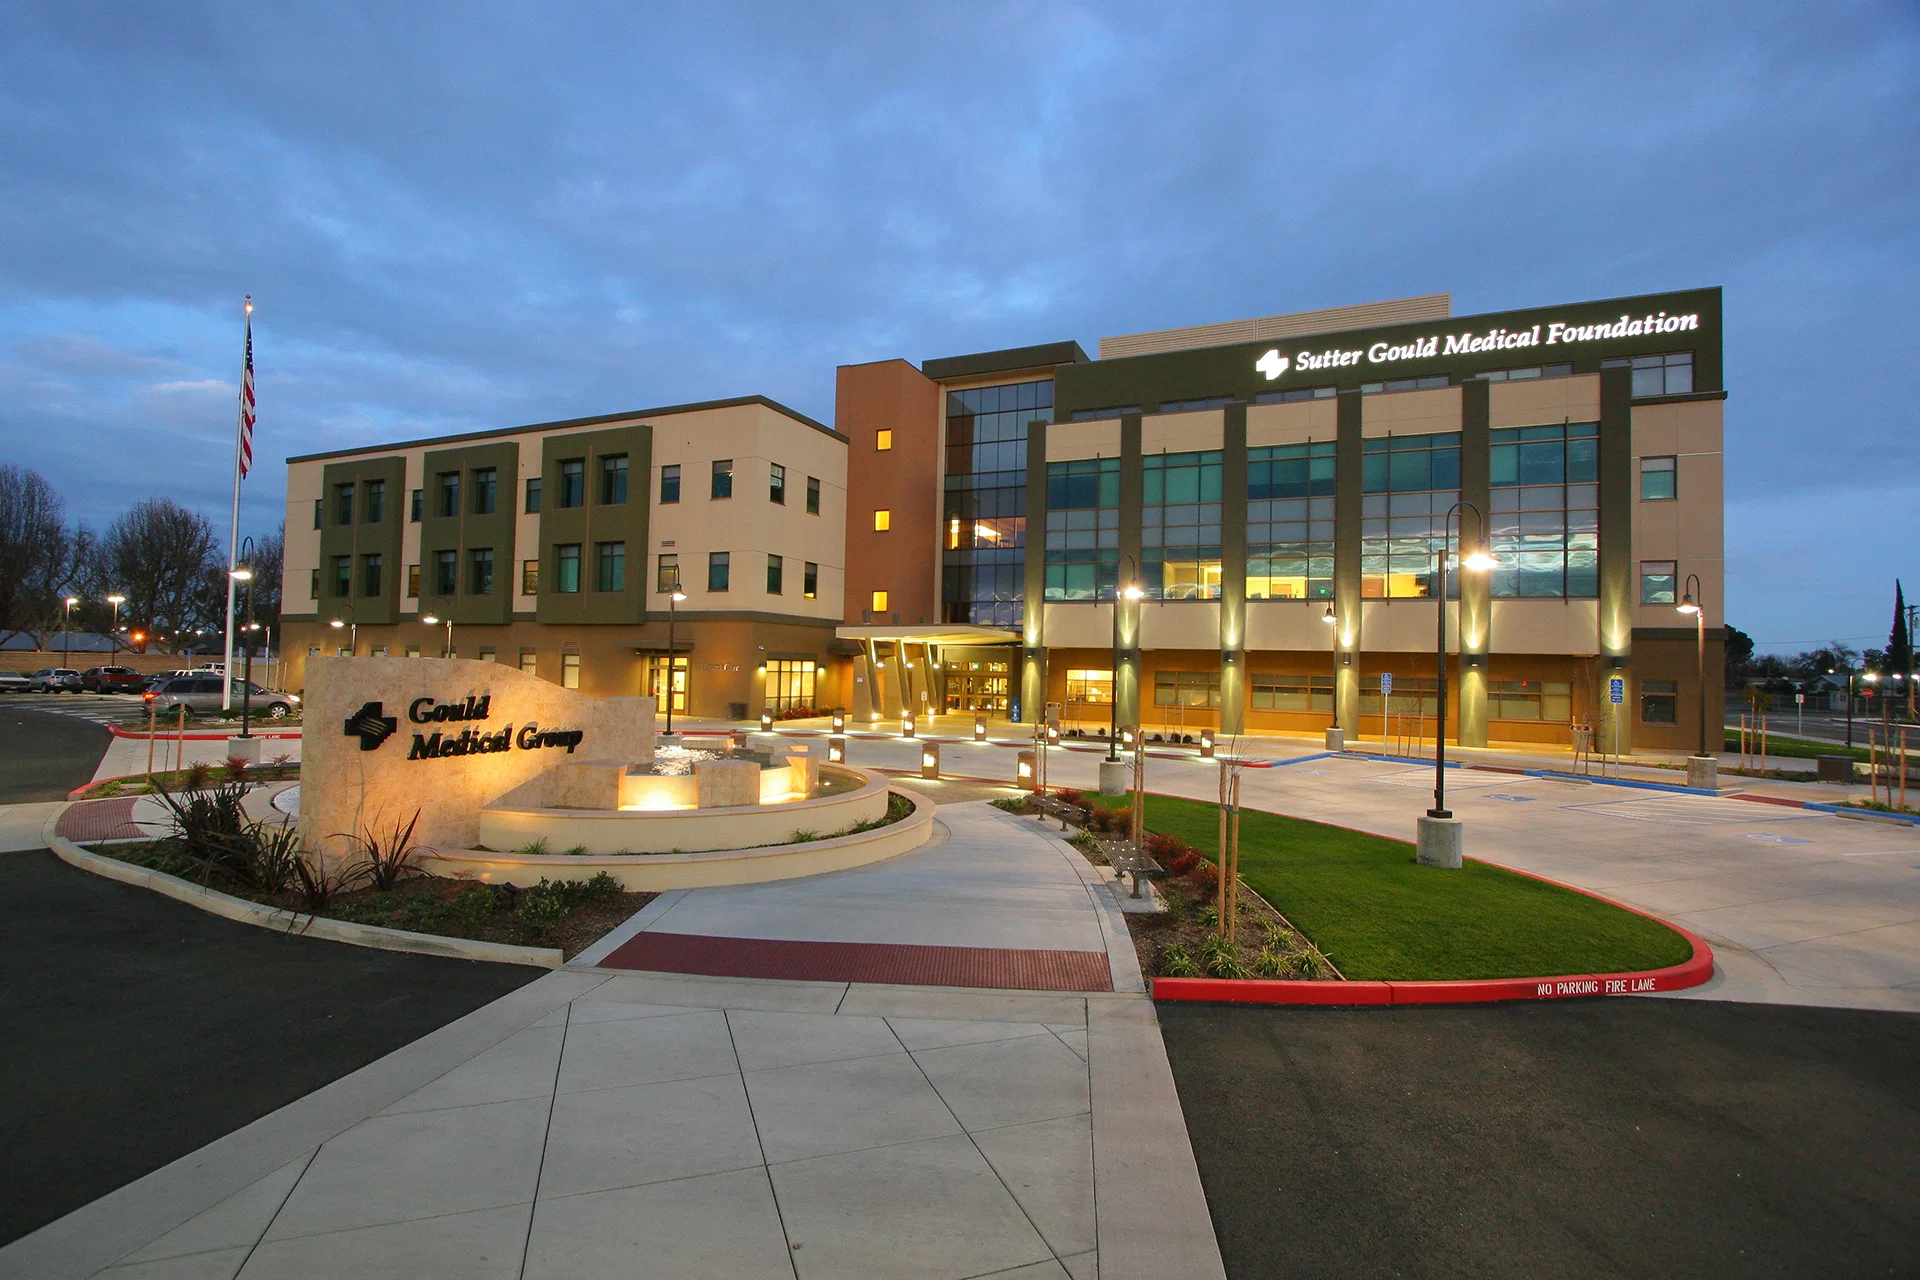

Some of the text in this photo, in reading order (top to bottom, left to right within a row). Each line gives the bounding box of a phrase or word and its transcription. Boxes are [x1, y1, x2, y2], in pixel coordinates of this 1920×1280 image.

[1295, 311, 1699, 371] Sutter Gould Medical Foundation
[408, 694, 492, 724] Gould
[406, 725, 584, 760] Medical Group
[1537, 978, 1656, 996] NO PARKING FIRE LANE
